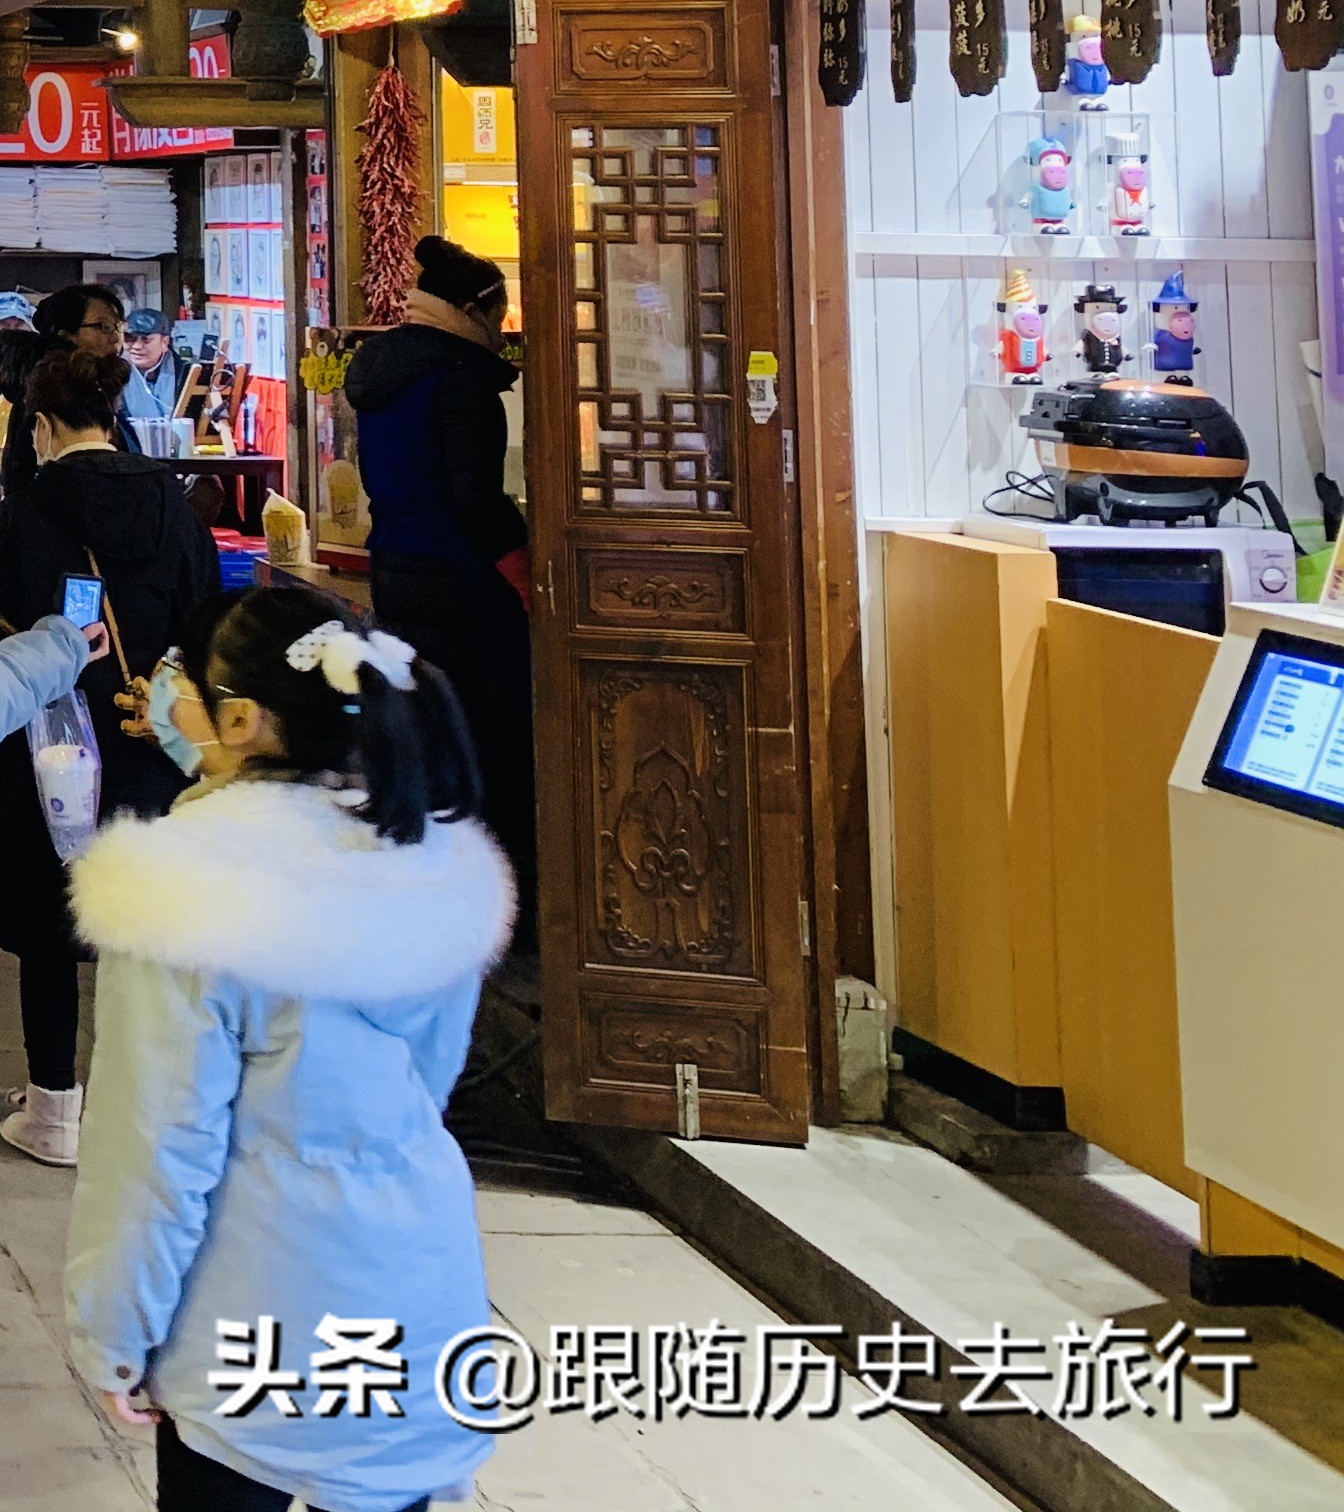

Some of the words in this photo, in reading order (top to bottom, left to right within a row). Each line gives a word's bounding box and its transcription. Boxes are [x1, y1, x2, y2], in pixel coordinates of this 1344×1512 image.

[976, 42, 990, 74] 15元
[1127, 22, 1142, 58] 15元
[80, 102, 104, 154] 元起
